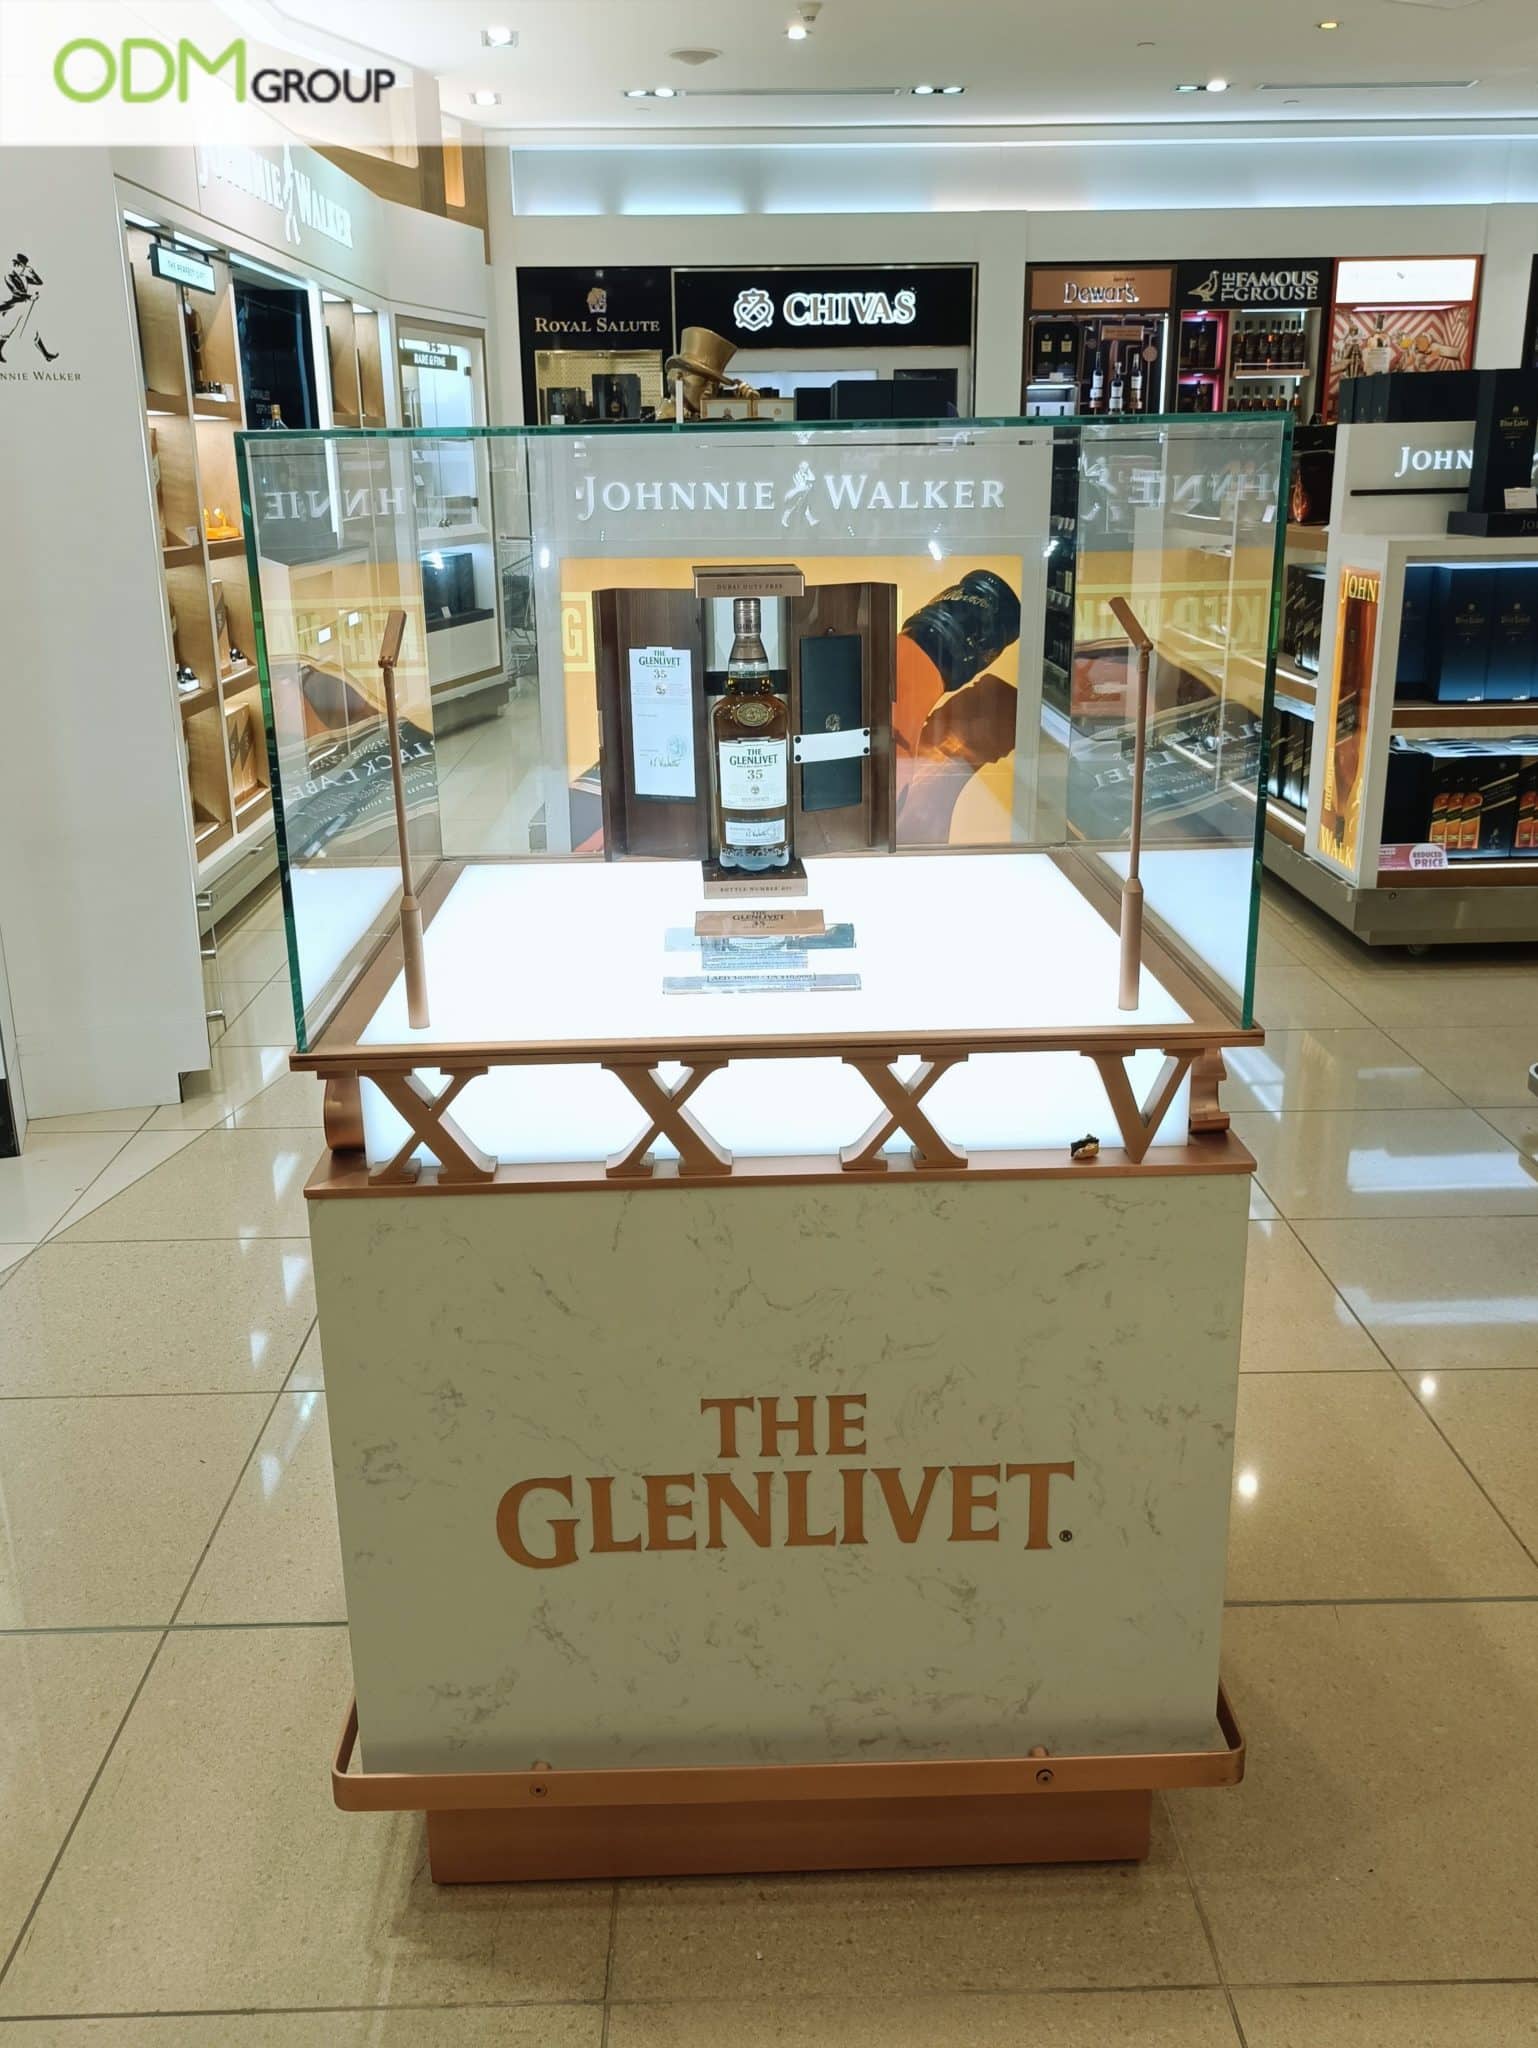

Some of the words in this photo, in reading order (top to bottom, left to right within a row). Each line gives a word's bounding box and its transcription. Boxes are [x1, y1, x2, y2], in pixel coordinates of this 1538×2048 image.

[1221, 272, 1236, 302] THE
[1236, 270, 1319, 287] FAMOUS
[1233, 286, 1318, 301] GROUSE
[782, 290, 917, 327] CHIVAS
[534, 316, 591, 334] ROYAL
[596, 317, 660, 334] SALUTE
[33, 370, 81, 381] WALKER
[577, 474, 776, 521] JOHNNIE
[824, 472, 1006, 511] WALKER
[1340, 569, 1381, 604] JOHN
[654, 649, 666, 657] THE
[638, 655, 681, 667] GLENLIVET
[653, 669, 667, 679] 35
[747, 748, 763, 756] THE
[729, 753, 778, 766] GLENLIVET
[746, 768, 764, 780] 35
[1414, 858, 1444, 868] PRICE
[700, 1393, 868, 1459] THE
